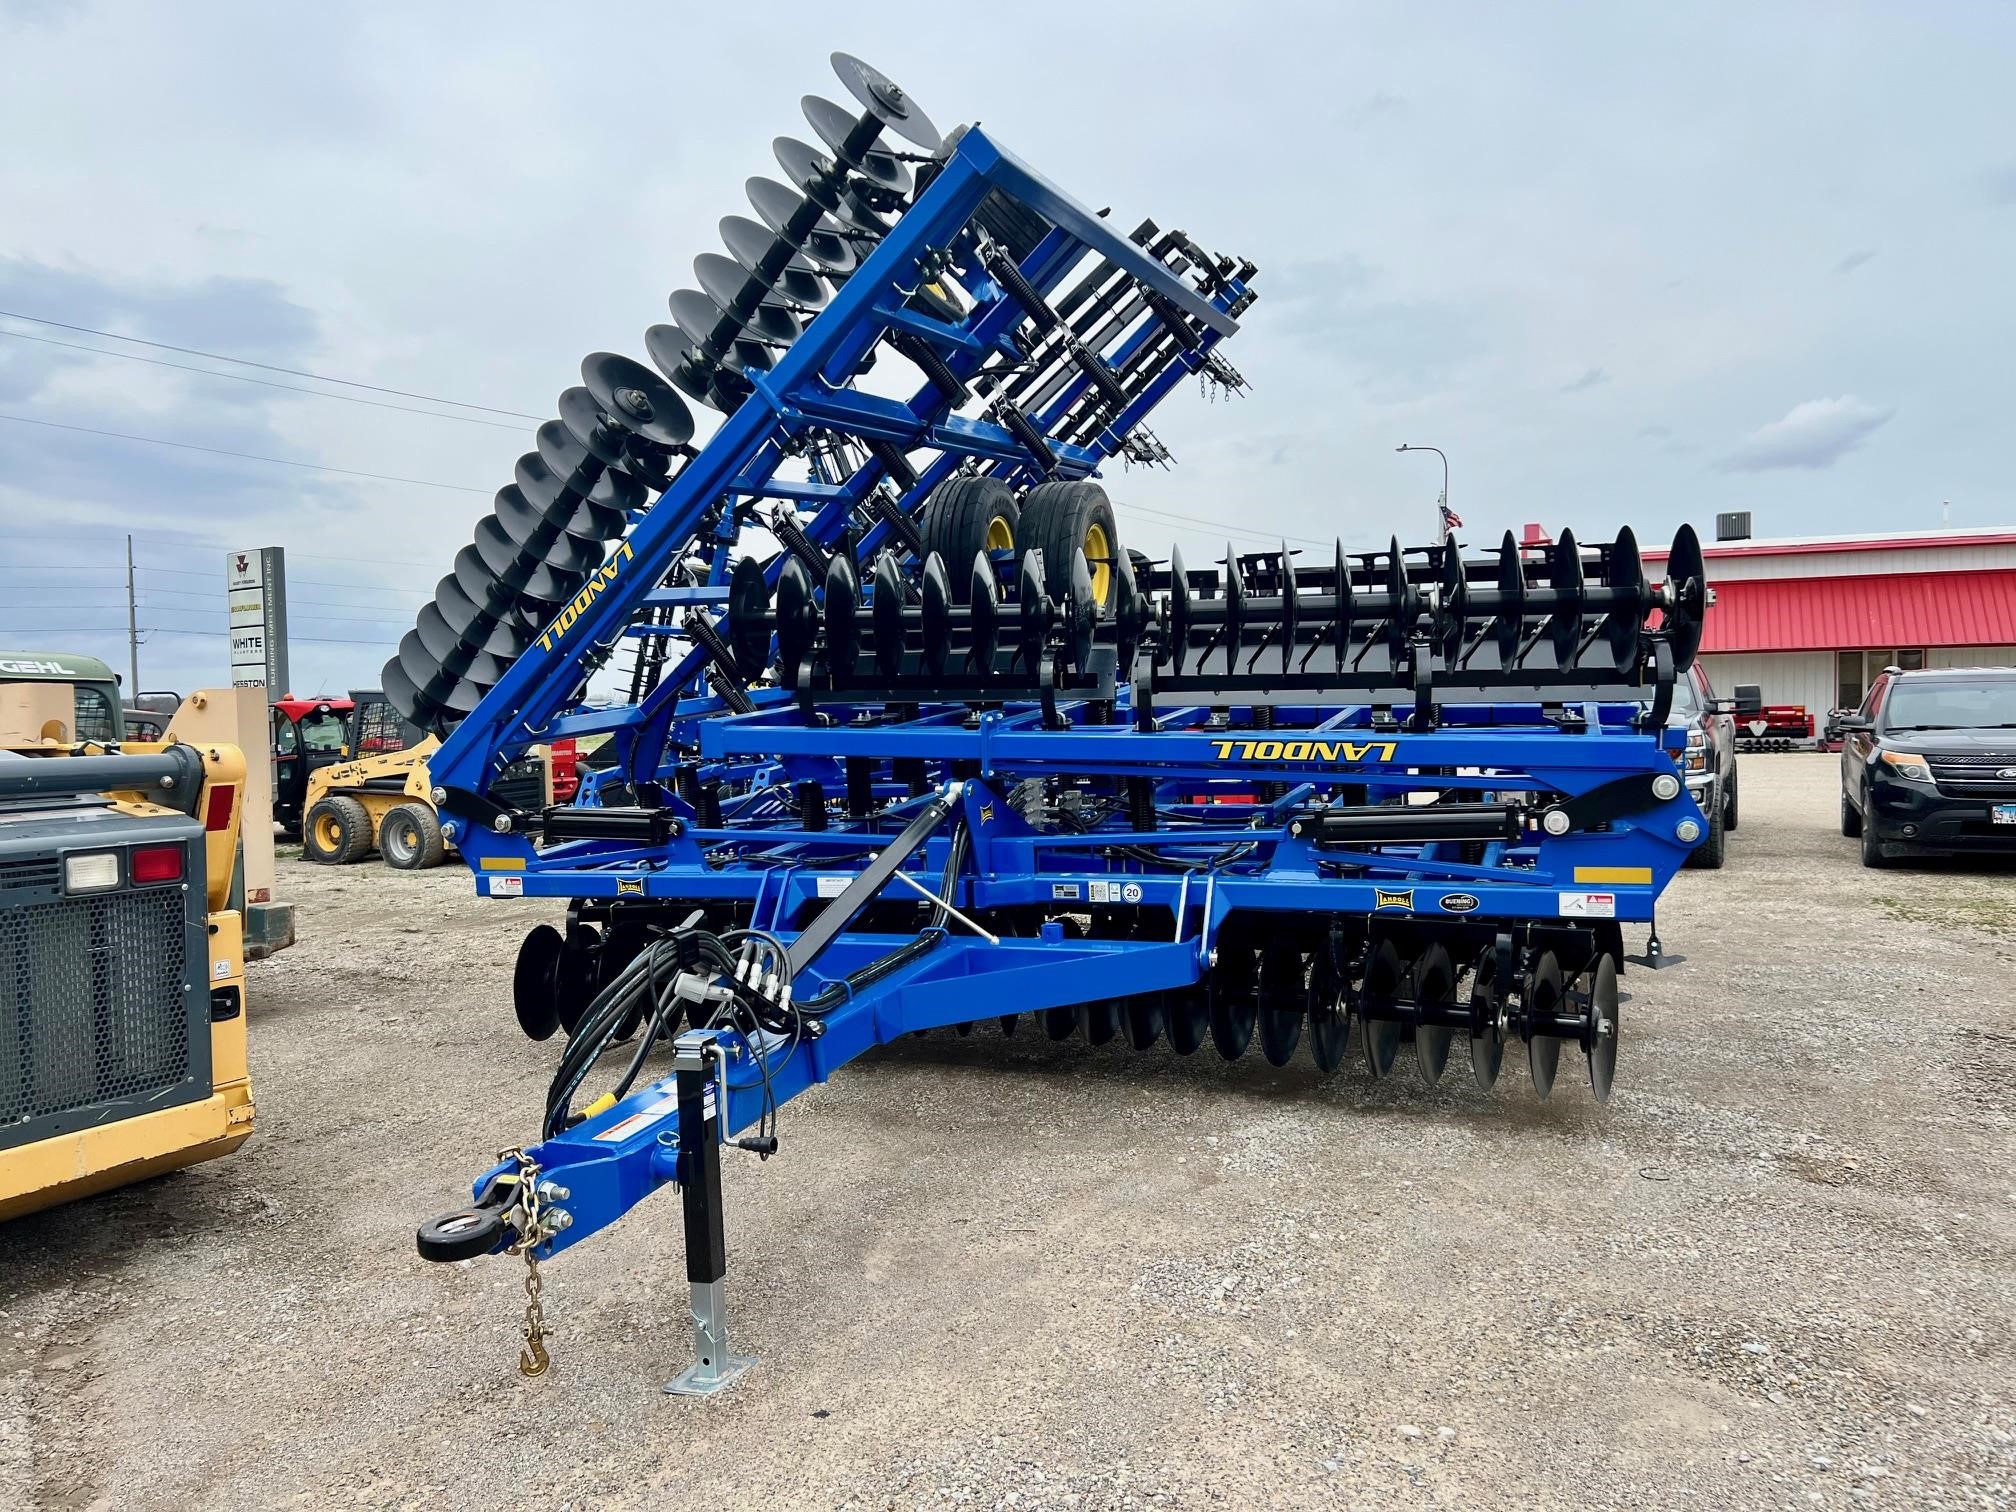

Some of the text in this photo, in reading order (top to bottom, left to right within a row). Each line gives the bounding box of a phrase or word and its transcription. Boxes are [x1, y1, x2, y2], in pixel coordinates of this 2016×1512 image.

[535, 540, 635, 653] LANDOLL
[266, 578, 274, 636] IMPLEMENT
[232, 637, 262, 649] WHITE
[0, 660, 76, 675] GEHL
[233, 679, 266, 688] HESSTON
[1210, 740, 1398, 762] LANDOLL
[1126, 888, 1139, 897] 20
[1379, 893, 1410, 907] LANDOLL
